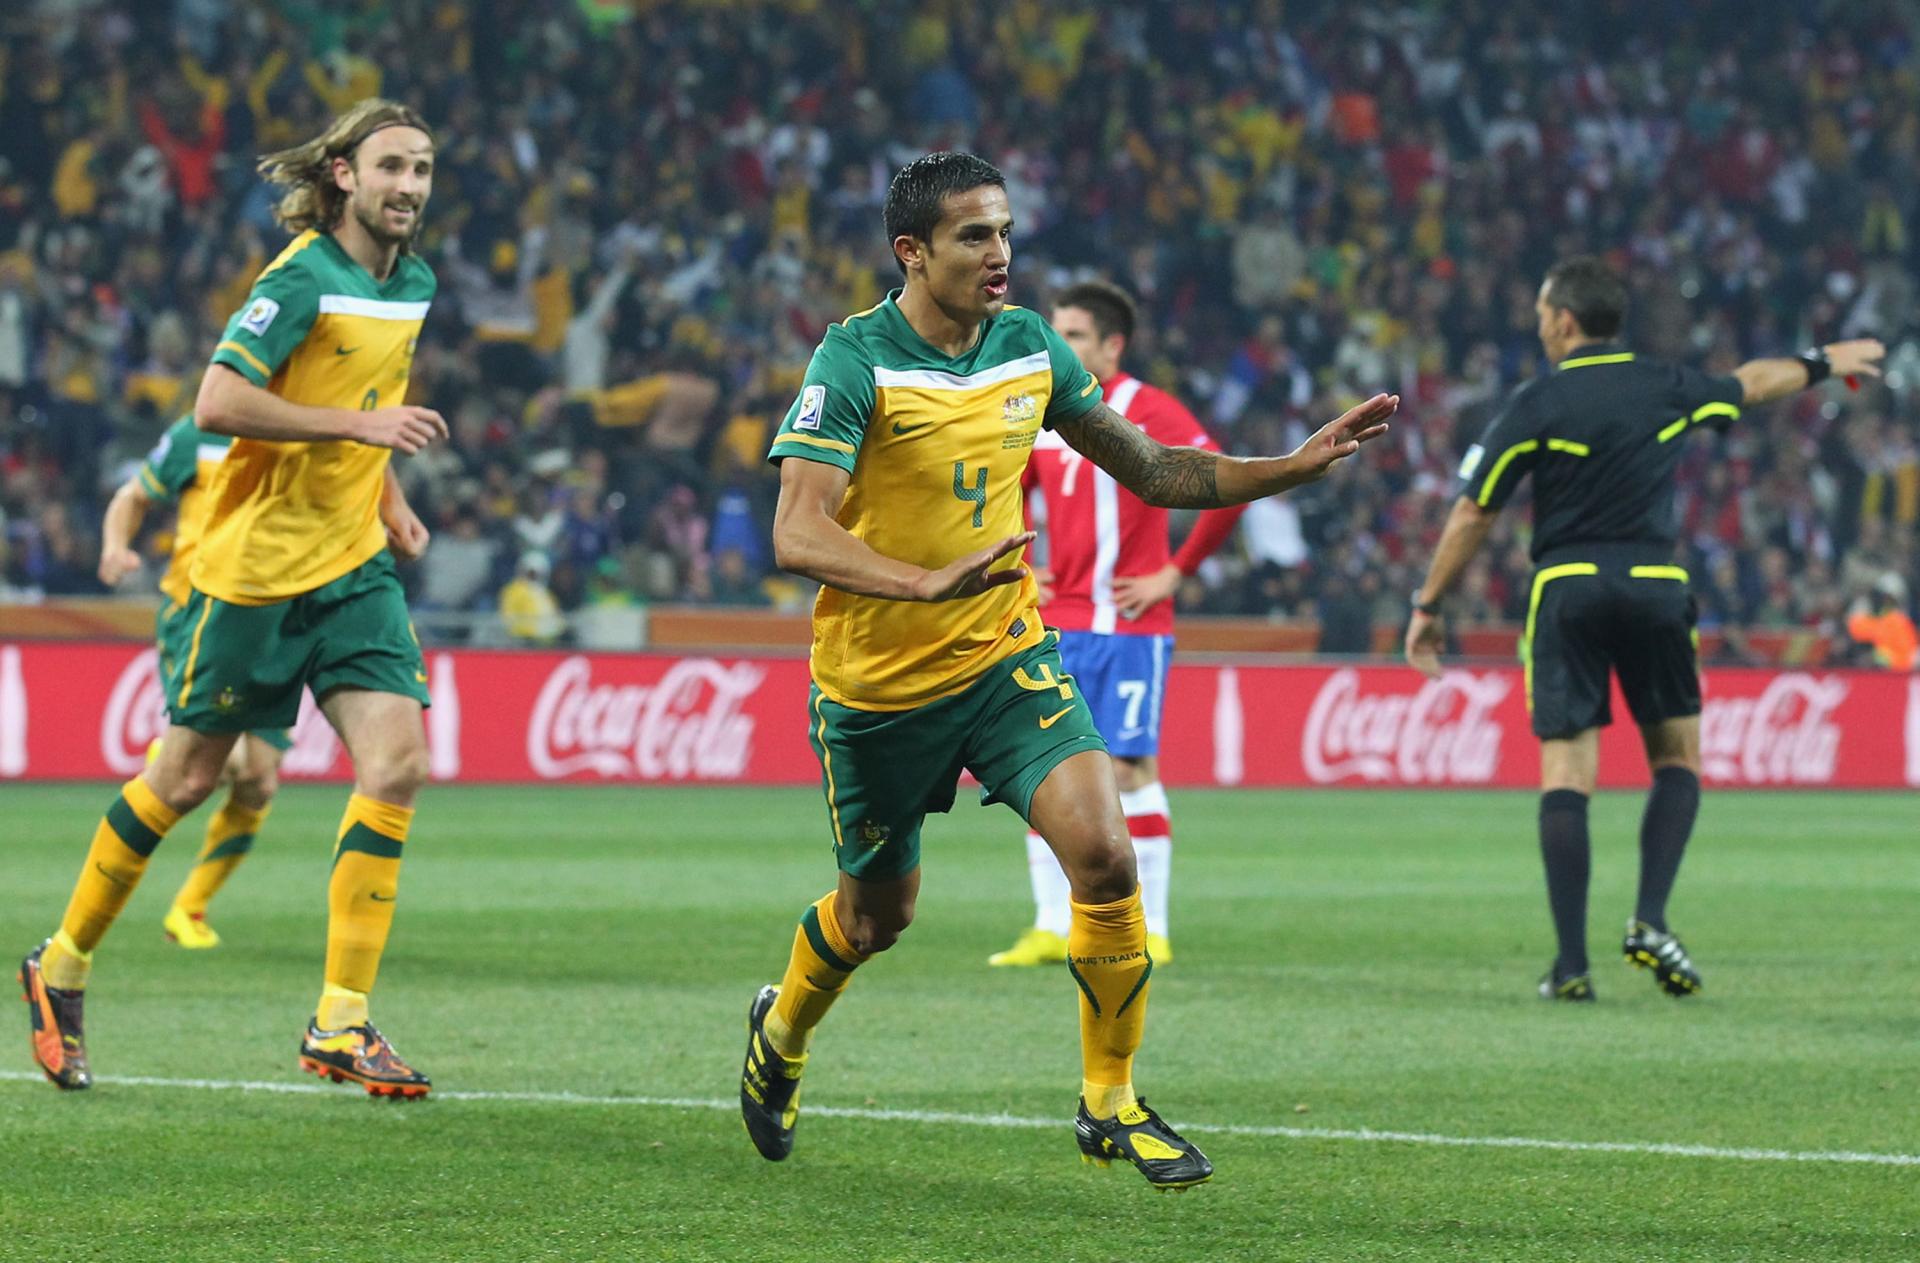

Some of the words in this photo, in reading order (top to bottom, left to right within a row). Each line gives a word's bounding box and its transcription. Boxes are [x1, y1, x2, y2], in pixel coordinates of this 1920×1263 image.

[953, 462, 988, 528] 4
[1059, 450, 1084, 497] 7
[1011, 663, 1075, 700] 4
[1116, 680, 1147, 730] 7
[1075, 951, 1143, 966] AUSTRALIA
